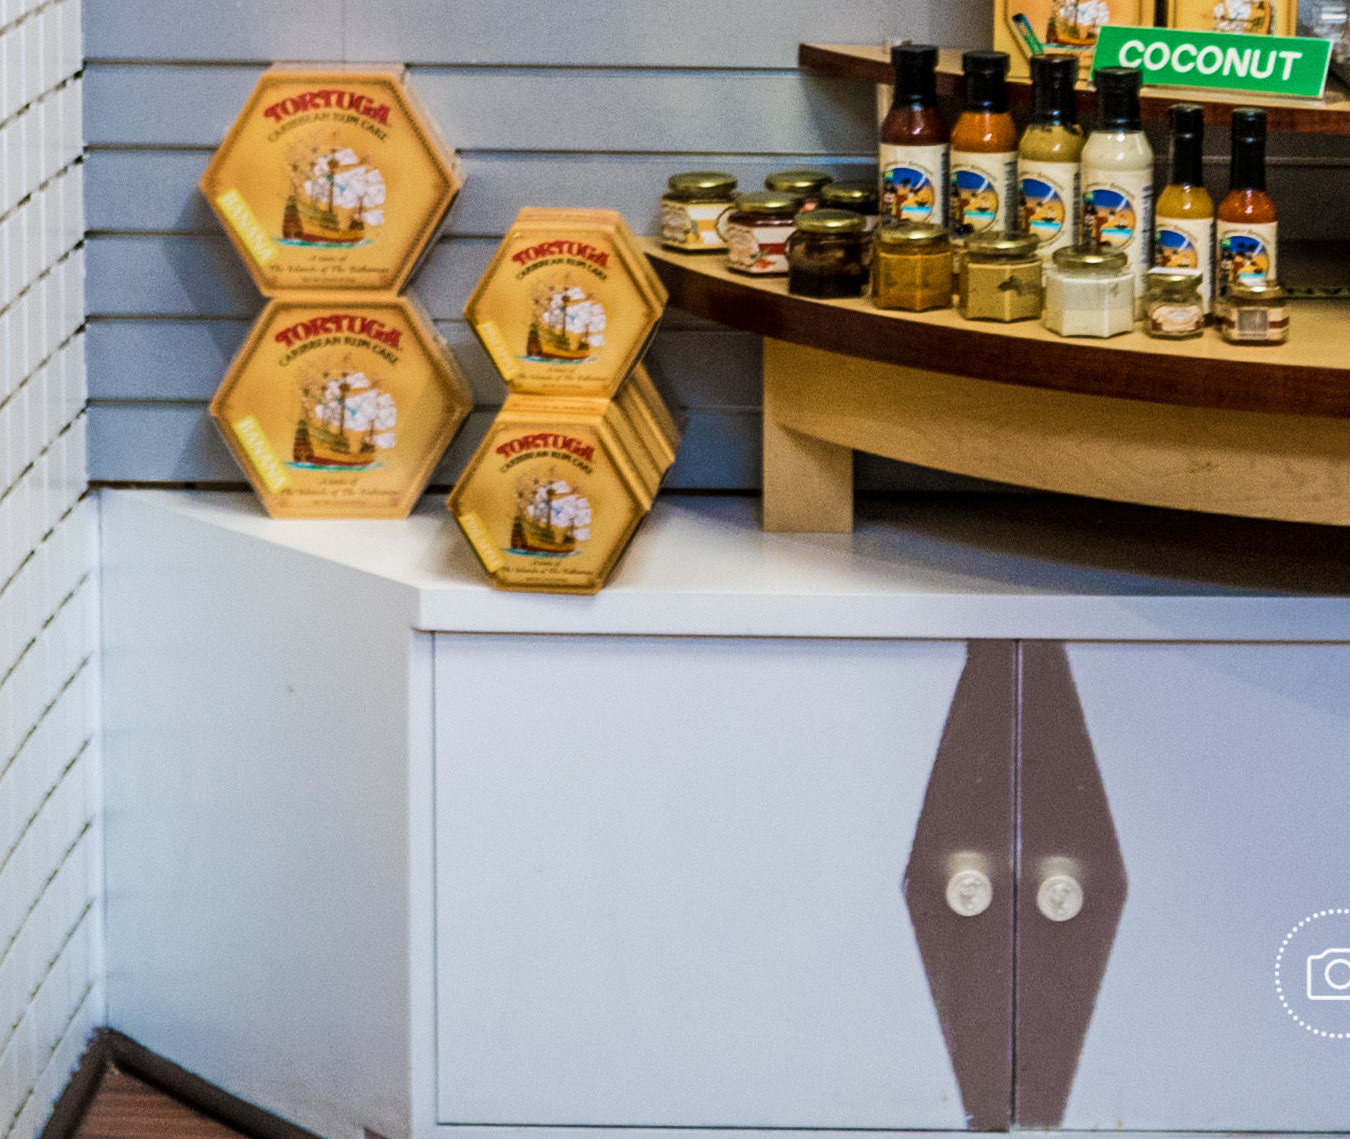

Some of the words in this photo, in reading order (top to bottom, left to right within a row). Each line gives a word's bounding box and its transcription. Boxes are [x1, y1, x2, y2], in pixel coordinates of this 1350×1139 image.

[1118, 39, 1303, 81] COCONUT
[262, 88, 390, 124] TORTUGA
[222, 191, 274, 262] BANANA
[512, 239, 608, 267] TORTUGA
[273, 313, 401, 348] TORTUGA
[238, 418, 286, 490] BANANA
[496, 433, 593, 460] TORTUGA
